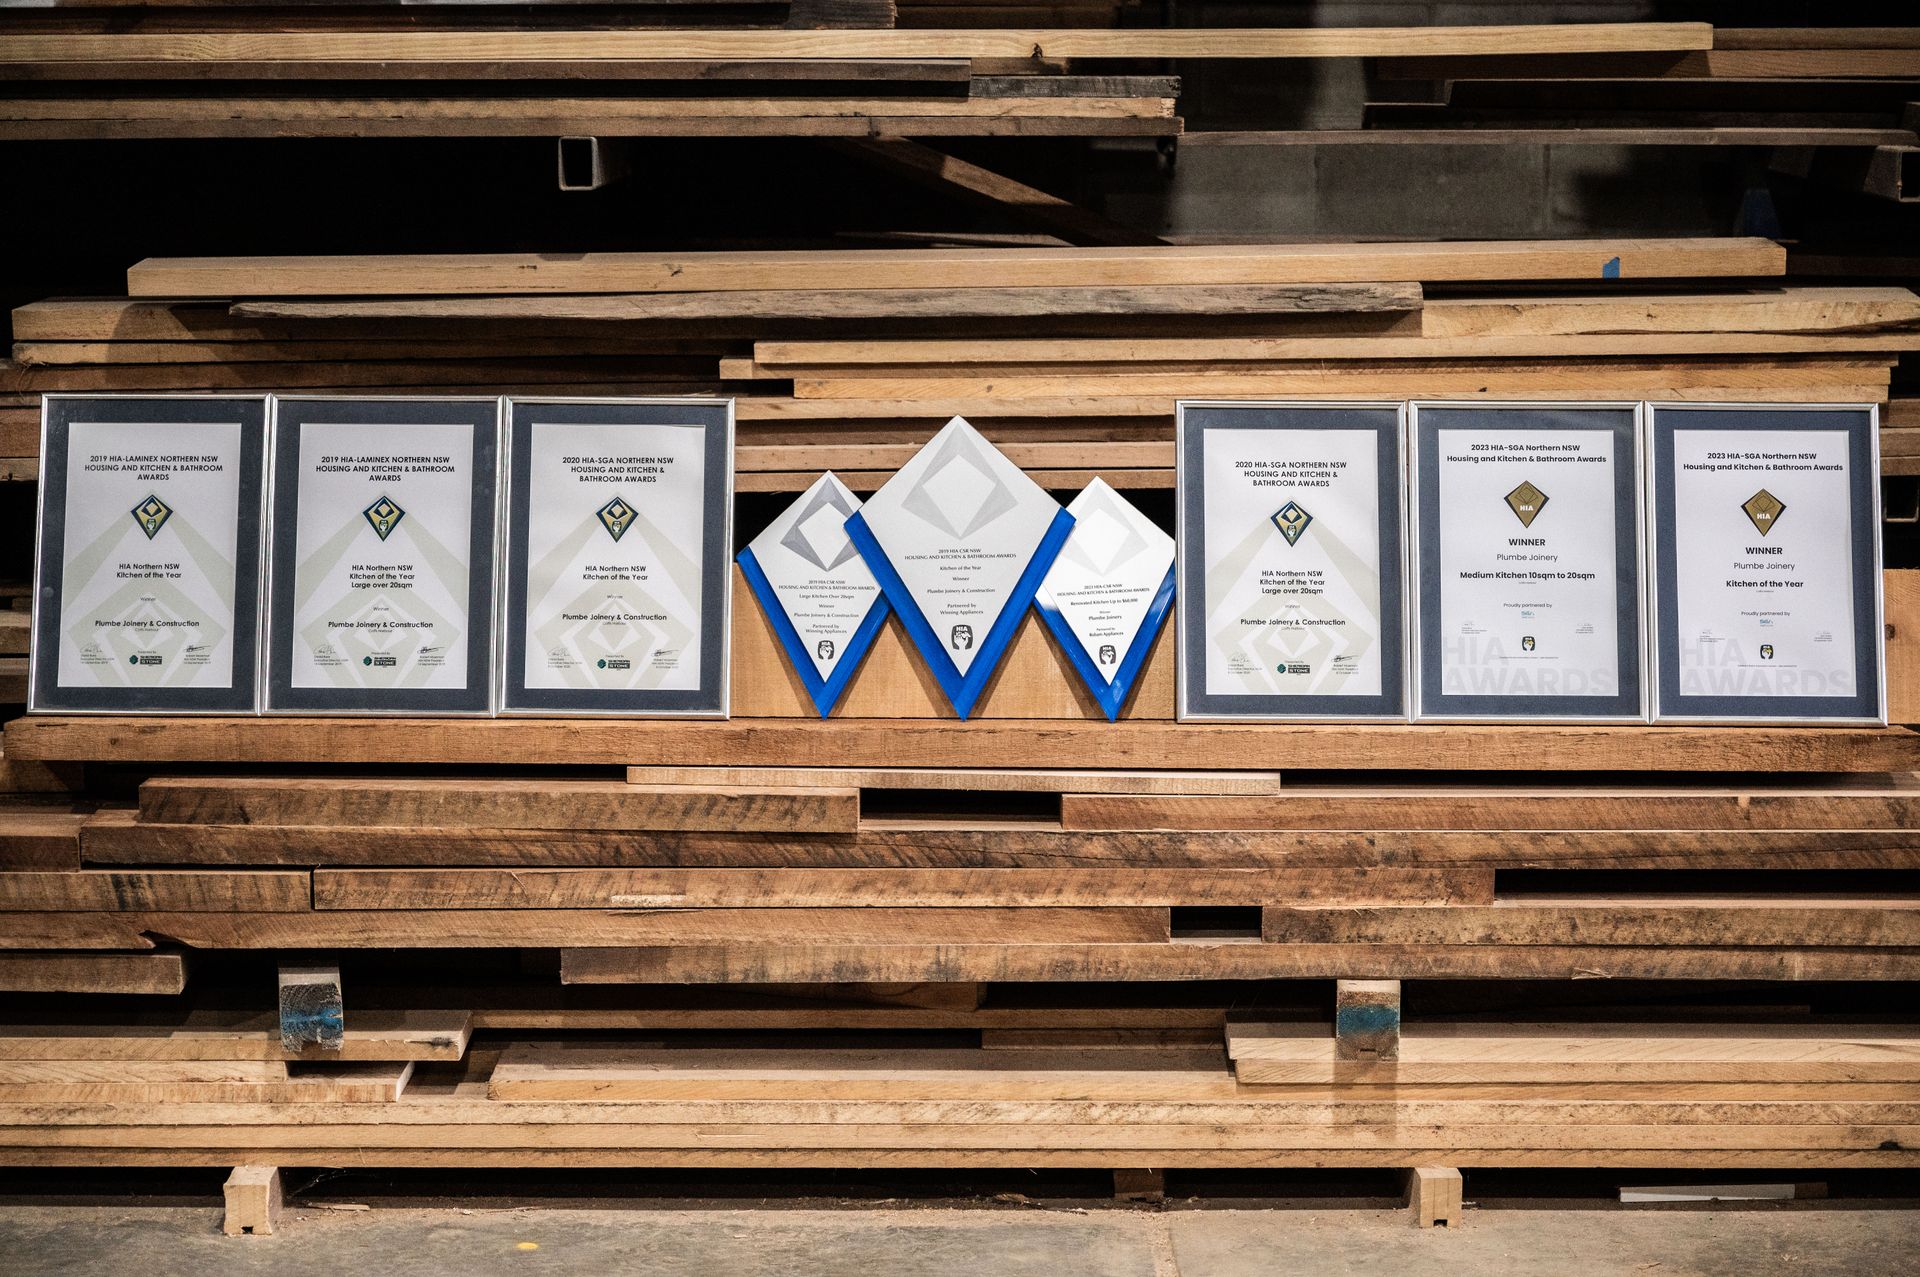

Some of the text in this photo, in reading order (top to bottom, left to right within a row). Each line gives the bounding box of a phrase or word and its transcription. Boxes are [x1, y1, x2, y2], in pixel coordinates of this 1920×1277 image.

[1529, 554, 1558, 562] Joinery
[1766, 562, 1795, 571] Joinery
[1529, 572, 1555, 580] 10sqm
[1567, 572, 1595, 580] 20sqm
[1445, 668, 1612, 694] AWARDS
[1681, 669, 1849, 695] AWARDS
